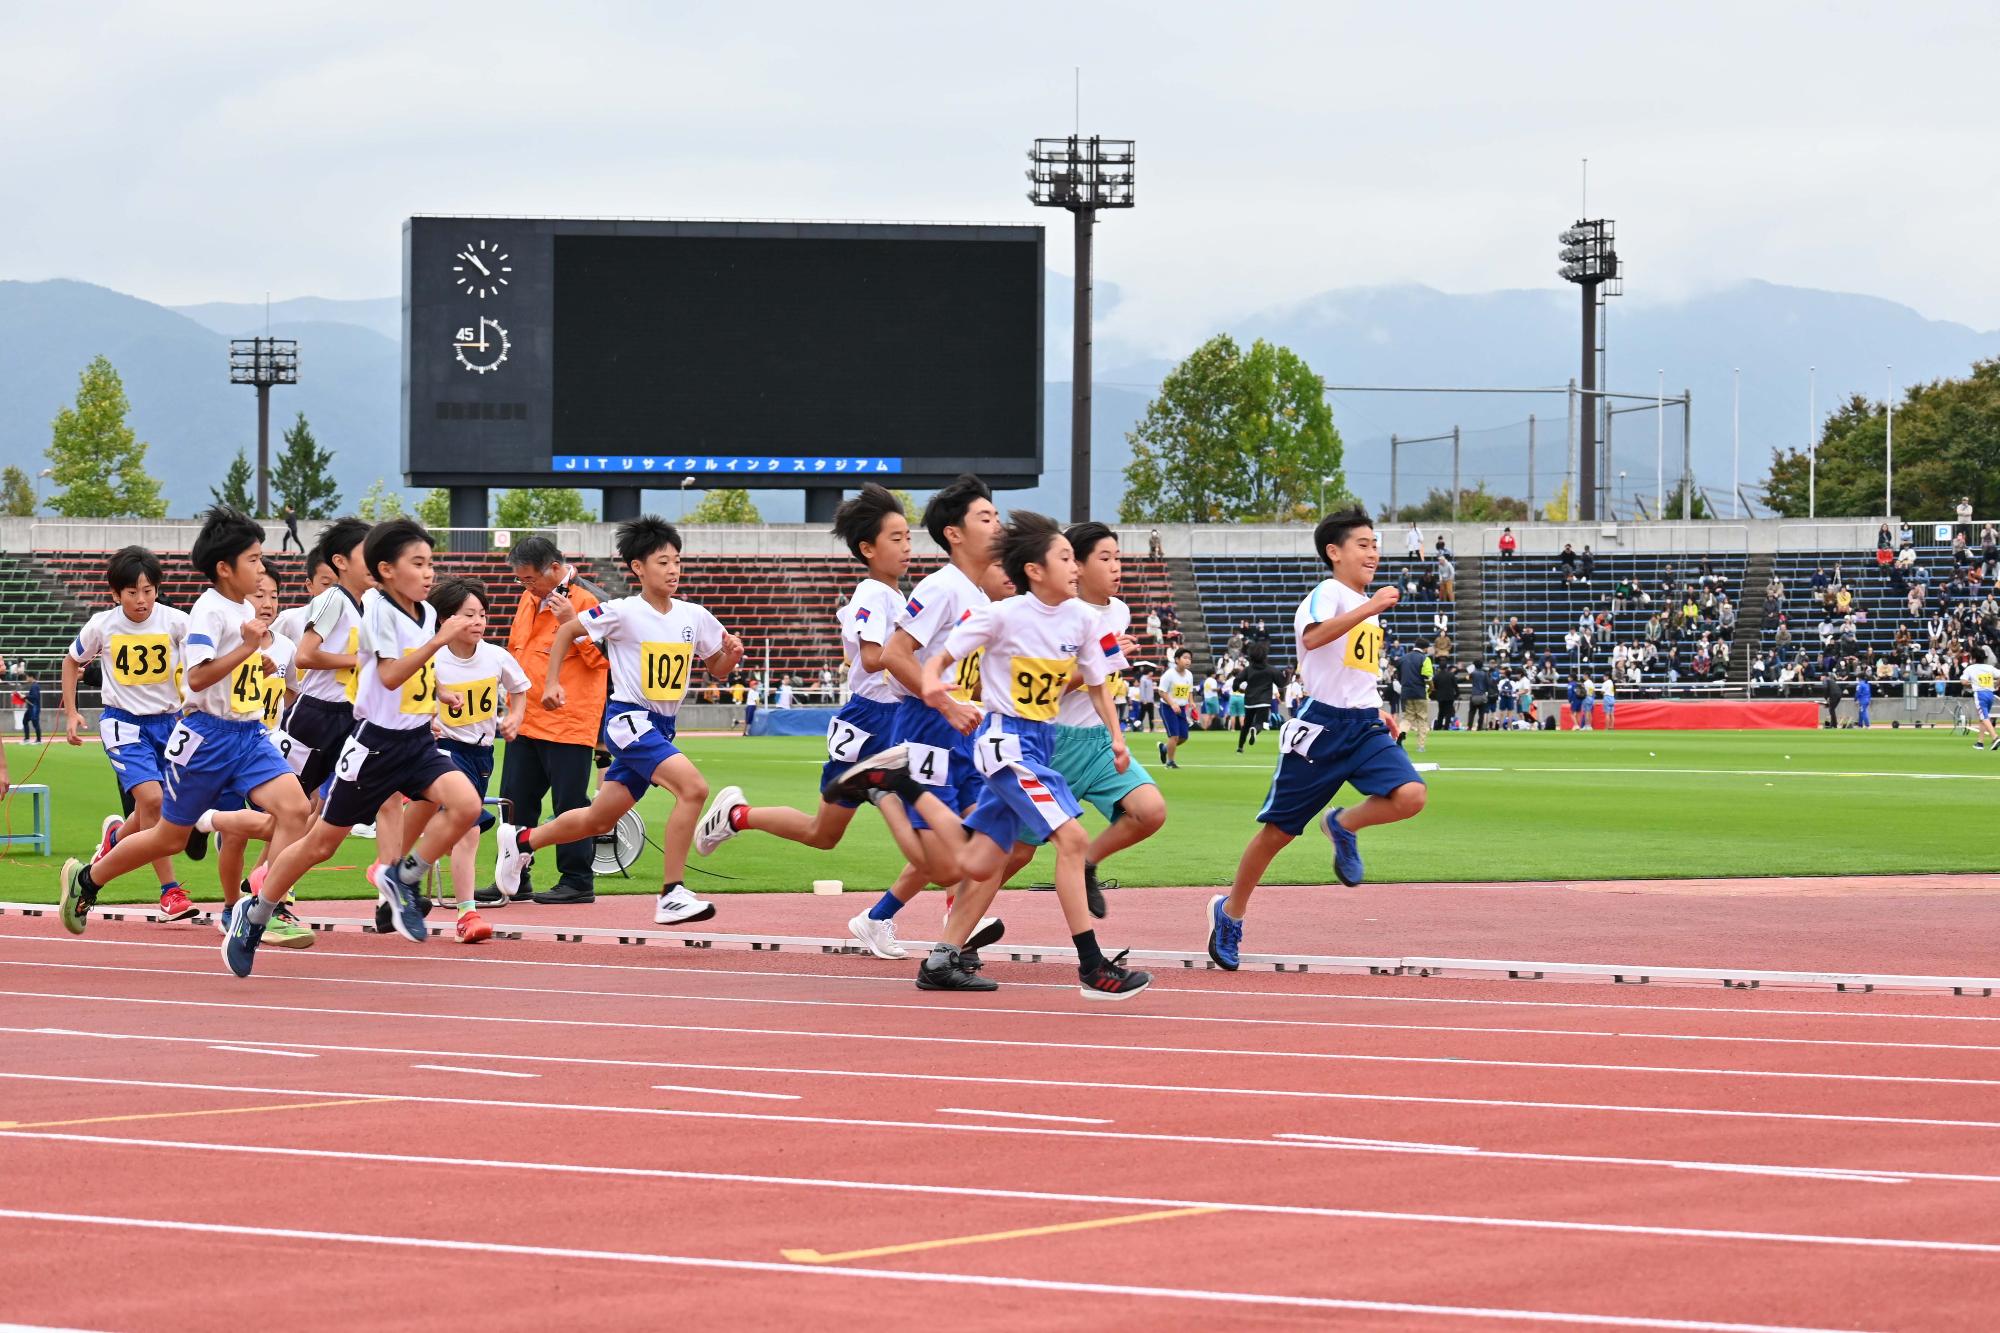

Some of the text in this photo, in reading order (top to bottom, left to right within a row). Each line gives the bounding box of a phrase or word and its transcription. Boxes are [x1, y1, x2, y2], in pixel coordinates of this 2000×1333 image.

[455, 328, 474, 341] 45
[565, 458, 888, 471] JIT リサイクルインク スタジアム
[1354, 631, 1381, 663] 61
[115, 645, 167, 676] 433
[114, 721, 120, 741] 1
[618, 714, 638, 735] 7
[169, 730, 190, 756] 3
[280, 738, 292, 760] 9
[341, 747, 356, 773] 6
[919, 750, 935, 780] 4
